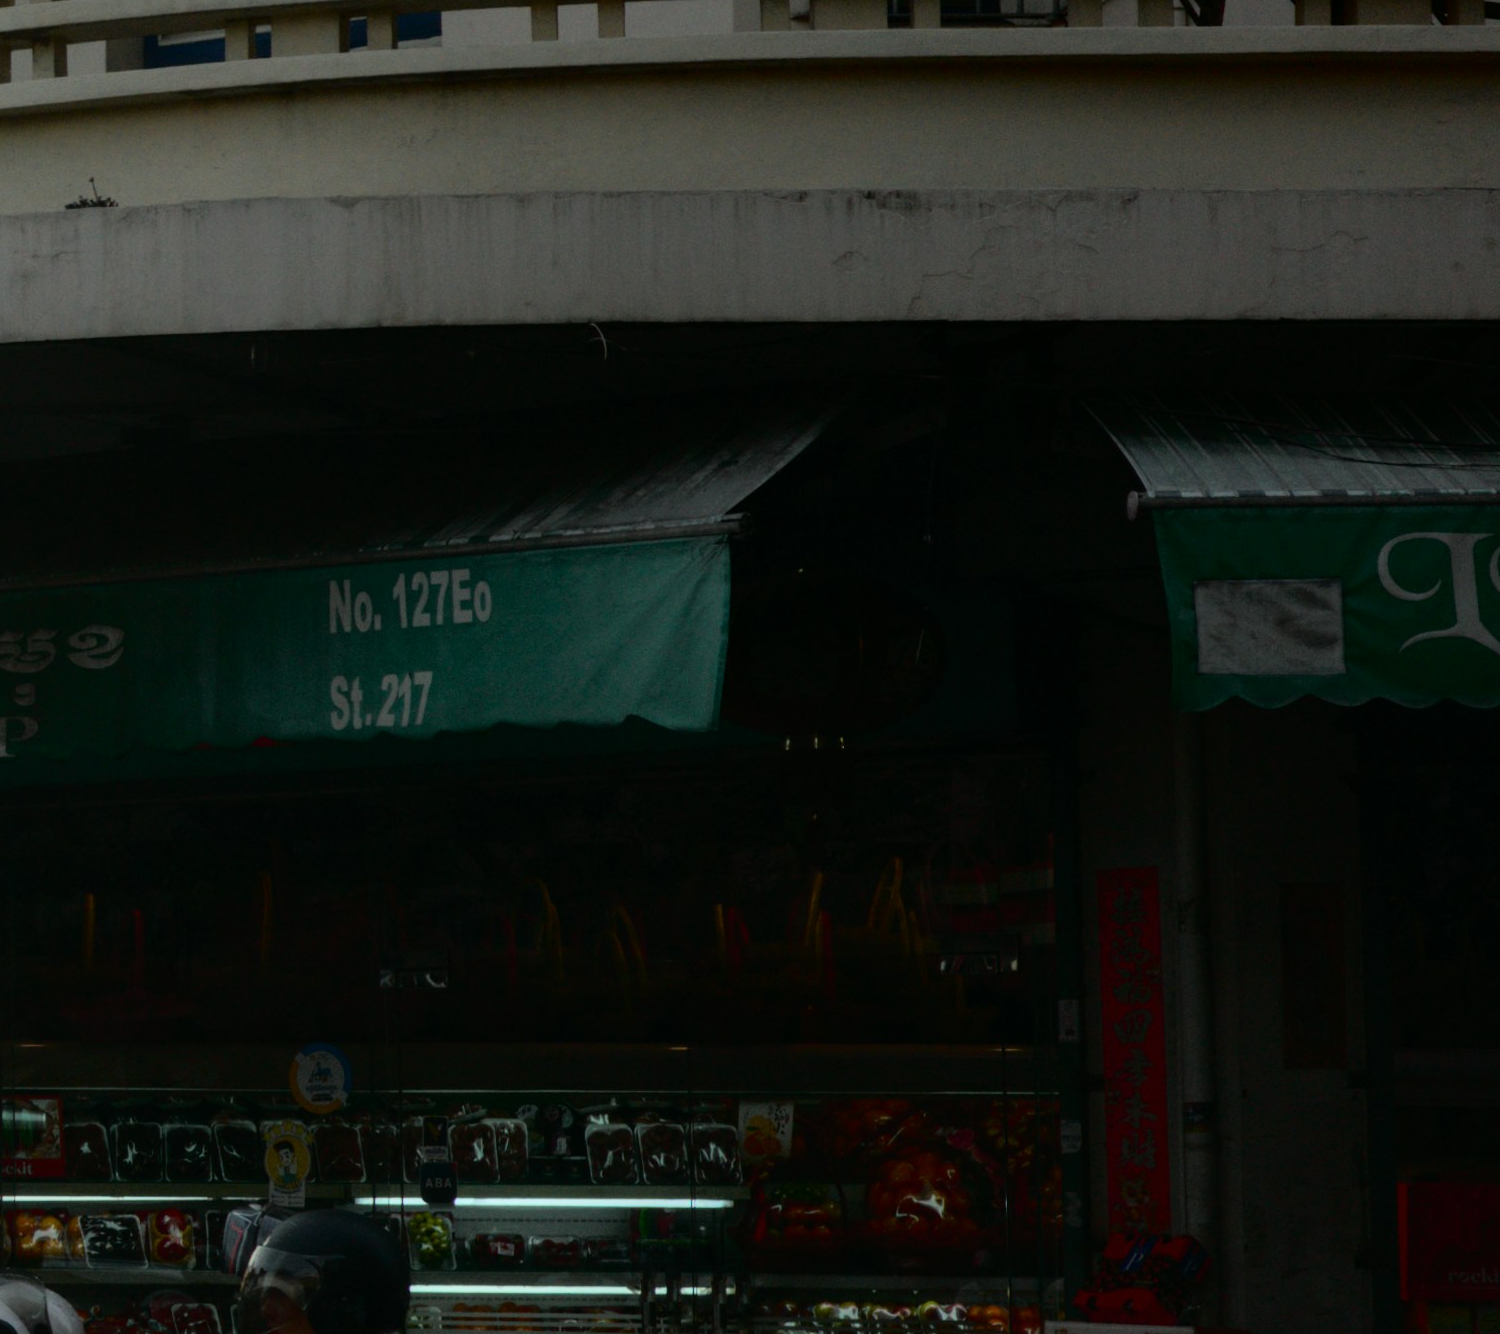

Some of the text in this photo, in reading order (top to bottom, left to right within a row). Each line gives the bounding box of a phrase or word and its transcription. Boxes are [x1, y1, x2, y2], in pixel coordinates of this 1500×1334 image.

[329, 567, 492, 634] No. 127Eo
[329, 670, 434, 732] St.217
[424, 1177, 452, 1189] ABA
[1447, 1267, 1500, 1285] rocki
